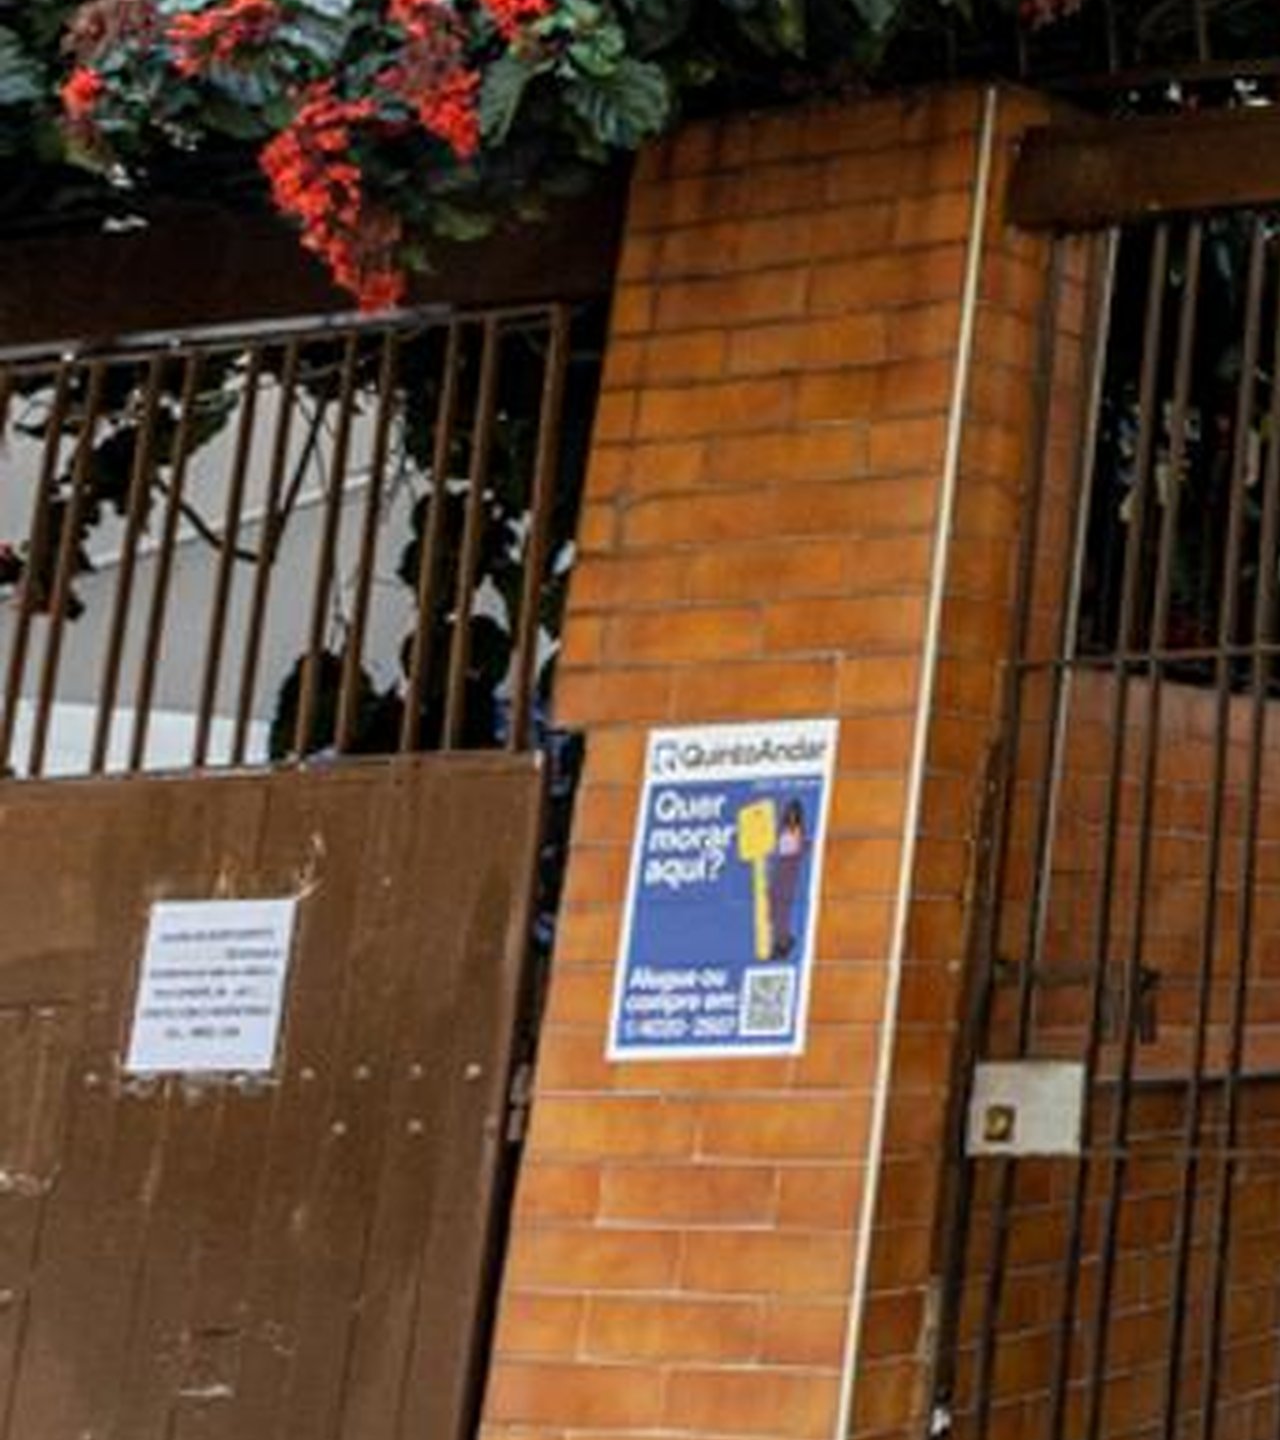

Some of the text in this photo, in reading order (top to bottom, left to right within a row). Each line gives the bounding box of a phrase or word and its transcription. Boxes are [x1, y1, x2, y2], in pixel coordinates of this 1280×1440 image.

[655, 790, 727, 821] Quer
[648, 824, 736, 852] morar
[643, 850, 726, 890] aqui?
